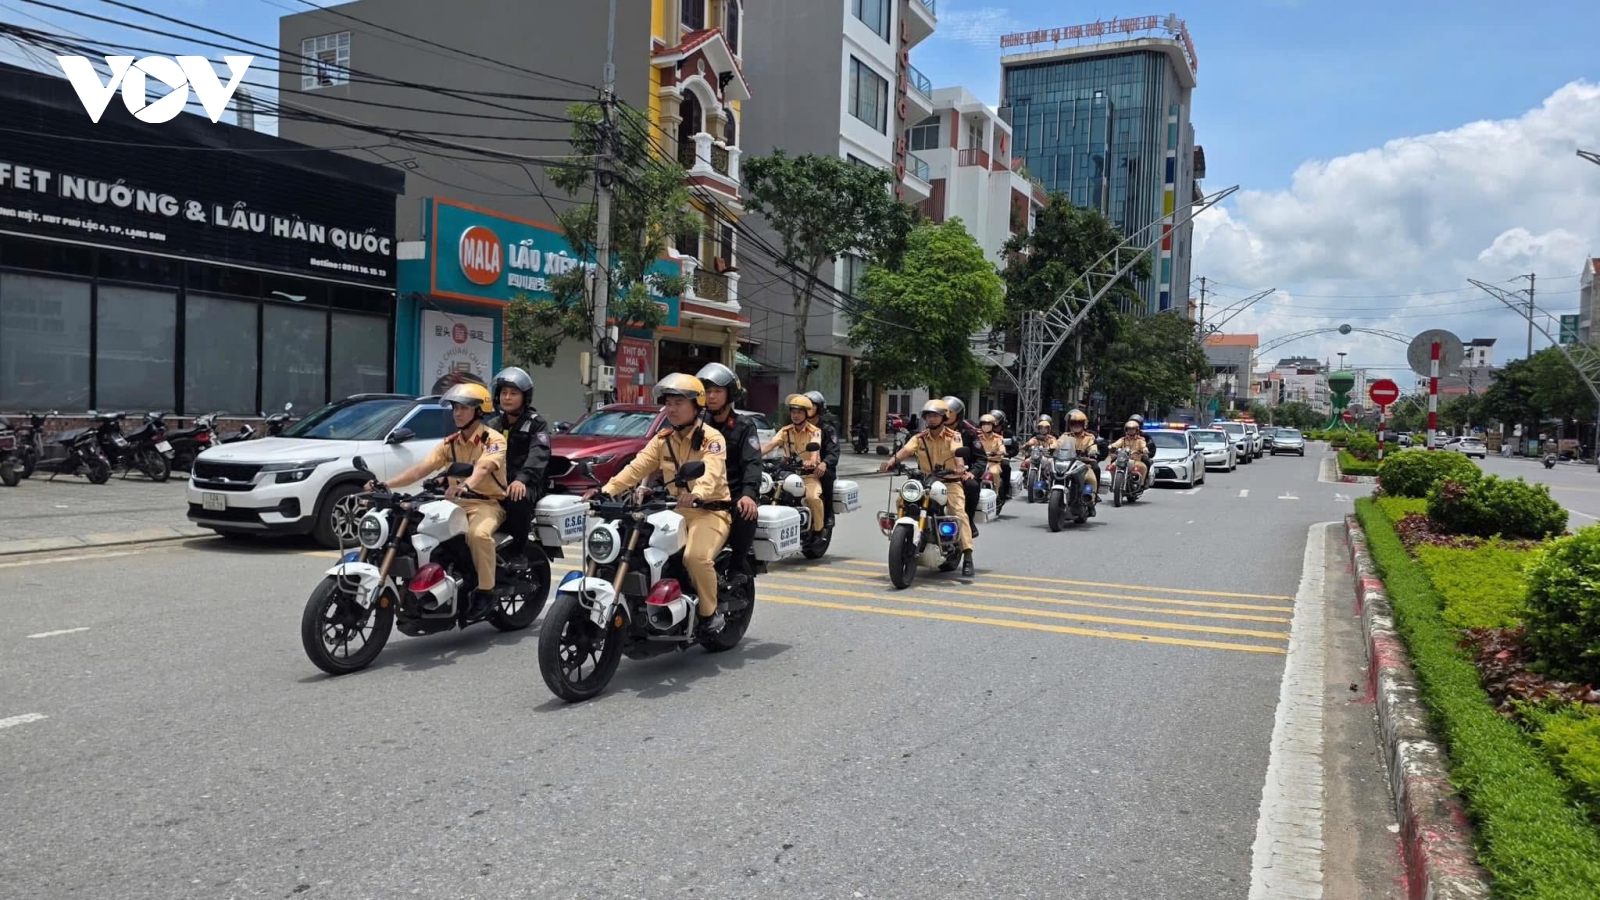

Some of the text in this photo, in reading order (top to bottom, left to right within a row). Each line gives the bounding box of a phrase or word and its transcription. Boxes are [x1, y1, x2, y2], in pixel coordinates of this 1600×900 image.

[185, 200, 207, 222] &
[273, 214, 325, 243] HÀN
[331, 228, 390, 256] QUỐC
[463, 238, 500, 272] MALA
[509, 239, 541, 272] LẨU
[780, 525, 798, 540] C.S.G.T
